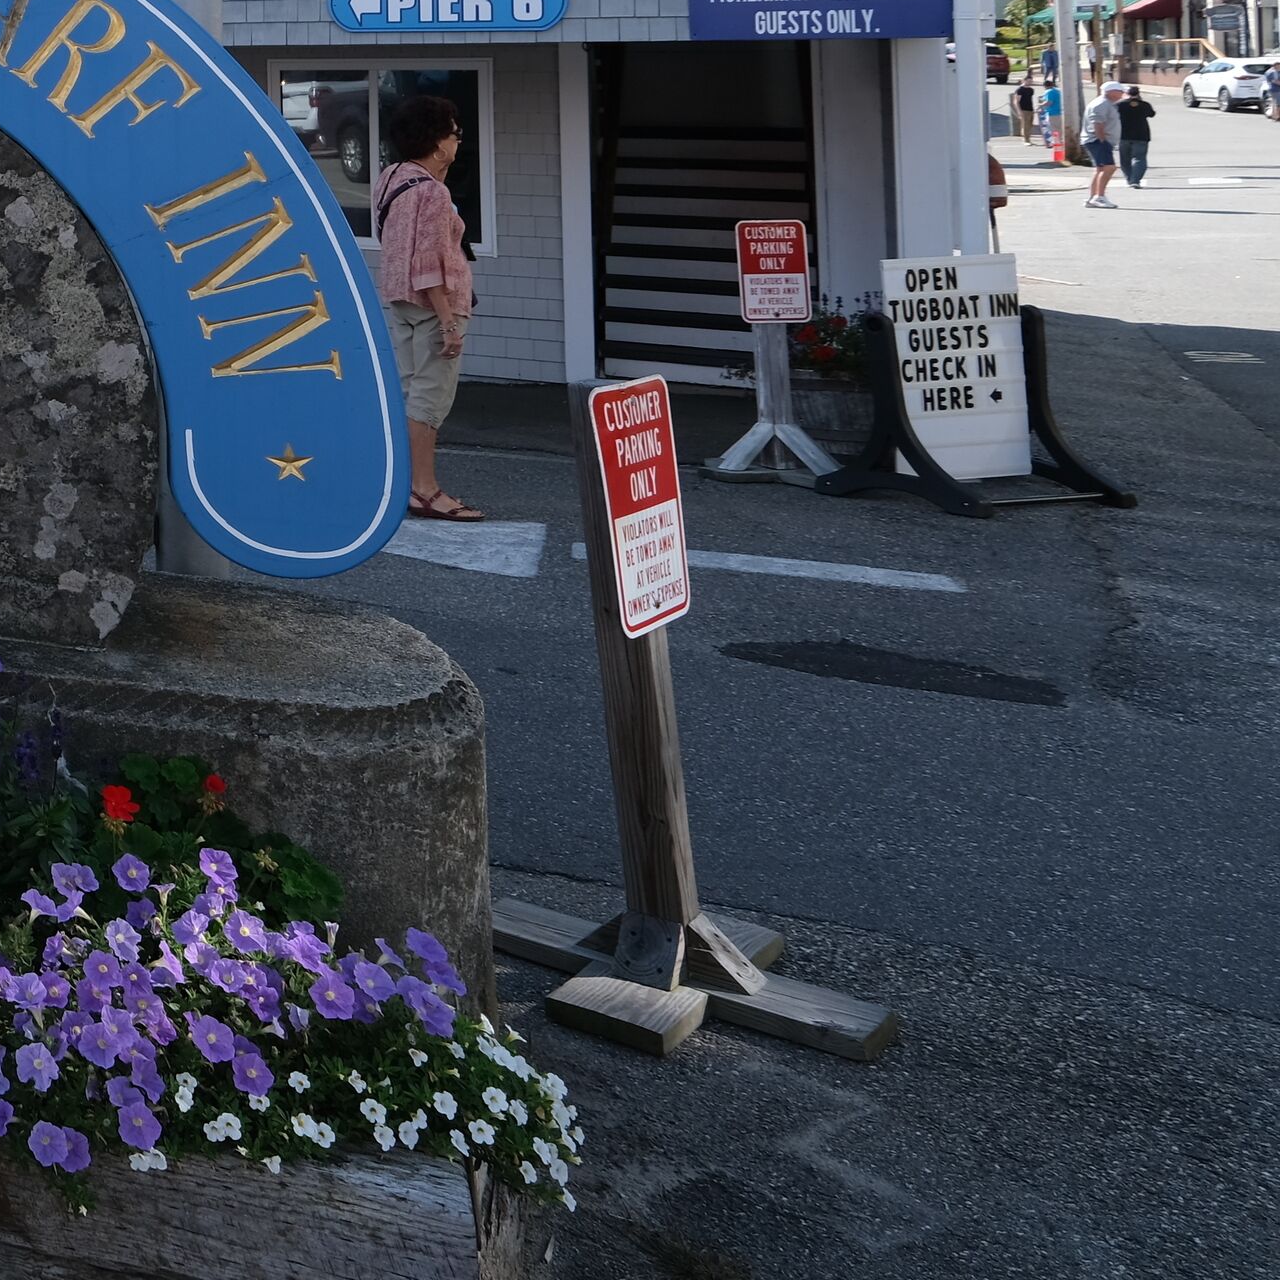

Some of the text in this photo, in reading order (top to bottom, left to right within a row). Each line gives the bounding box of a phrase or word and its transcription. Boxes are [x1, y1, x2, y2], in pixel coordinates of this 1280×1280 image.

[755, 9, 880, 35] GUESTS ONLY.
[744, 226, 797, 239] CUSTOMER
[750, 242, 794, 254] PARKING
[142, 150, 343, 383] INN
[760, 257, 786, 270] ONLY
[905, 267, 958, 293] OPEN
[888, 293, 1020, 324] TUGBOAT INN
[908, 324, 989, 352] GUESTS
[902, 354, 997, 383] CHECK IN
[603, 390, 662, 432] CUSTOMER
[922, 385, 975, 412] HERE
[615, 427, 662, 468] PARKING
[630, 466, 657, 502] ONLY
[622, 509, 674, 543] VIOLATORS WILL
[625, 532, 676, 568] BE TOWED AWAY
[636, 558, 672, 589] AT VEHICLE
[628, 578, 684, 618] OWNER'S EXPENSE
